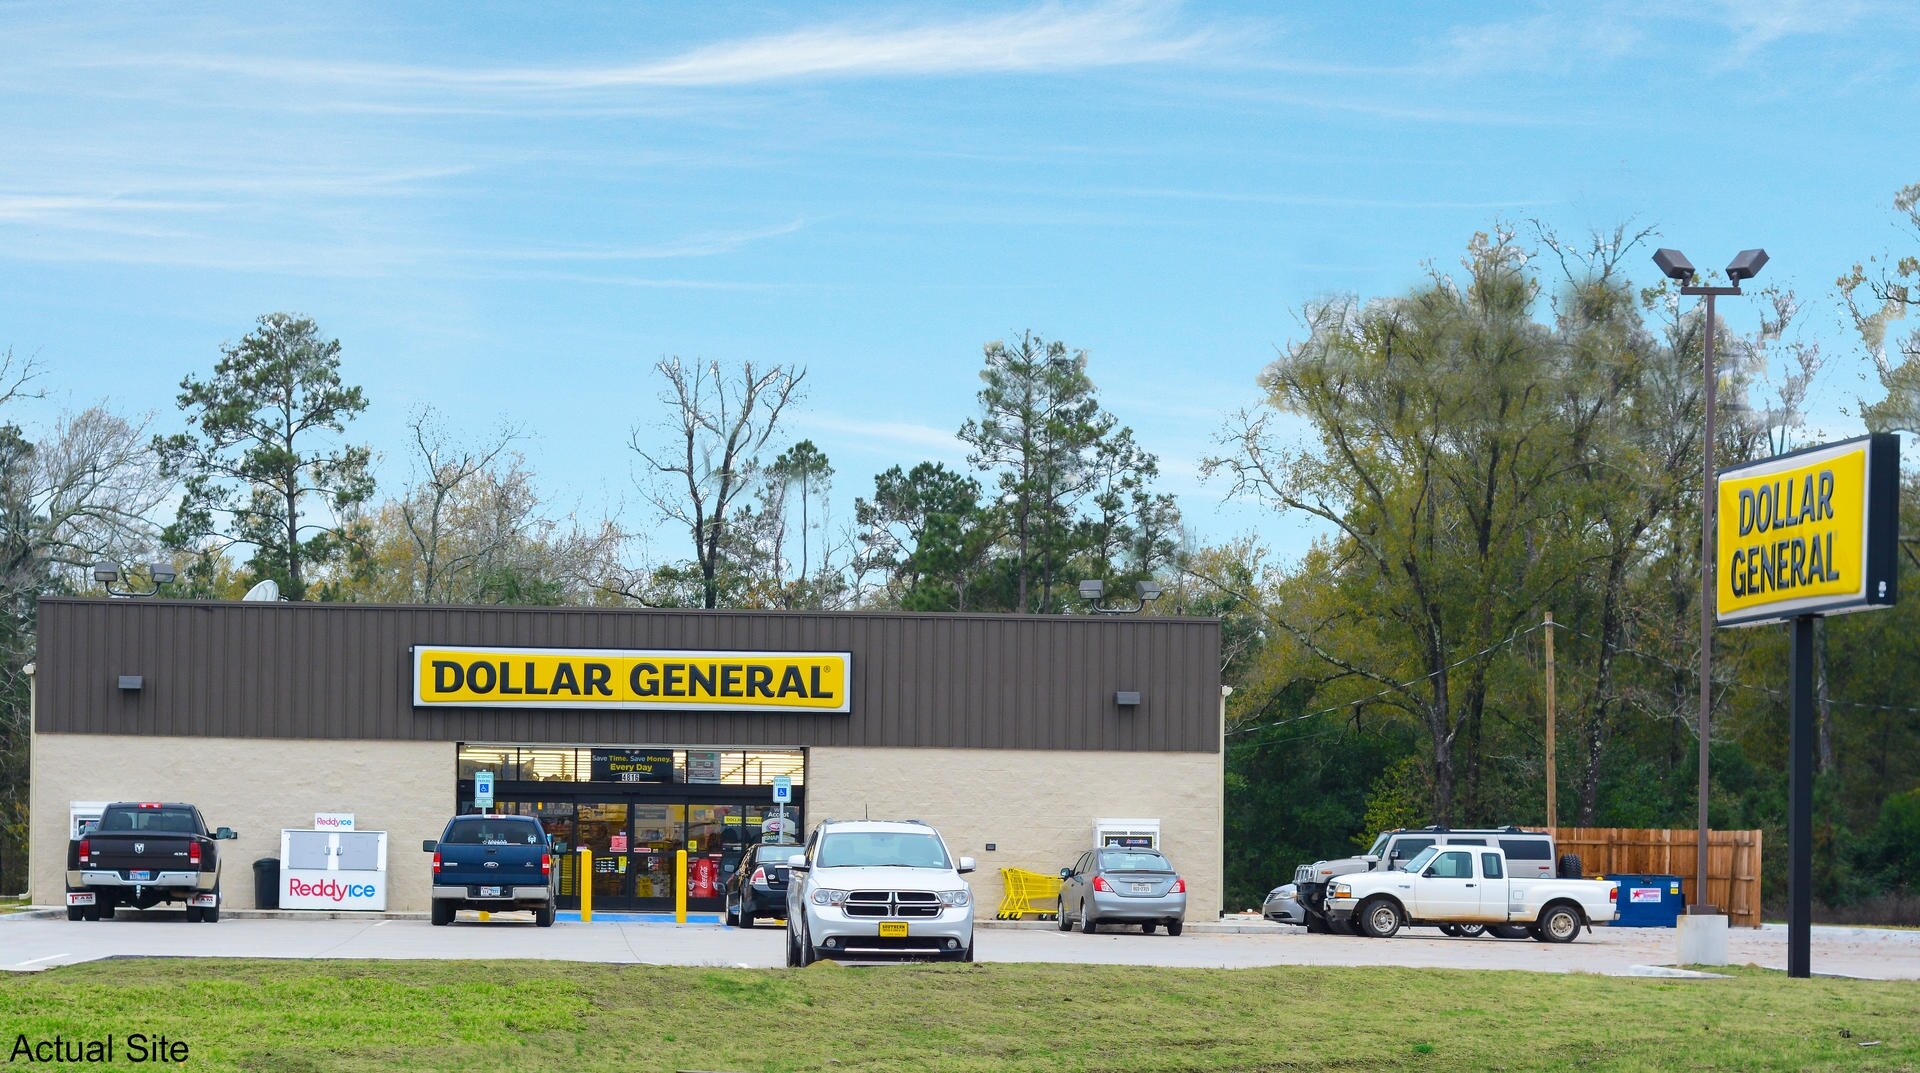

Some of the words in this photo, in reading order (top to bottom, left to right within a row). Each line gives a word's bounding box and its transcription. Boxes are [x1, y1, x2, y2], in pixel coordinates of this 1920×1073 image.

[1738, 469, 1834, 537] DOLLAR
[1731, 531, 1839, 599] GENERAL
[431, 659, 613, 696] DOLLAR
[629, 662, 833, 699] GENERAL
[647, 756, 672, 764] Money.
[610, 763, 635, 772] Every
[636, 763, 652, 772] Day
[69, 893, 93, 904] TEAM
[191, 895, 214, 905] TAM
